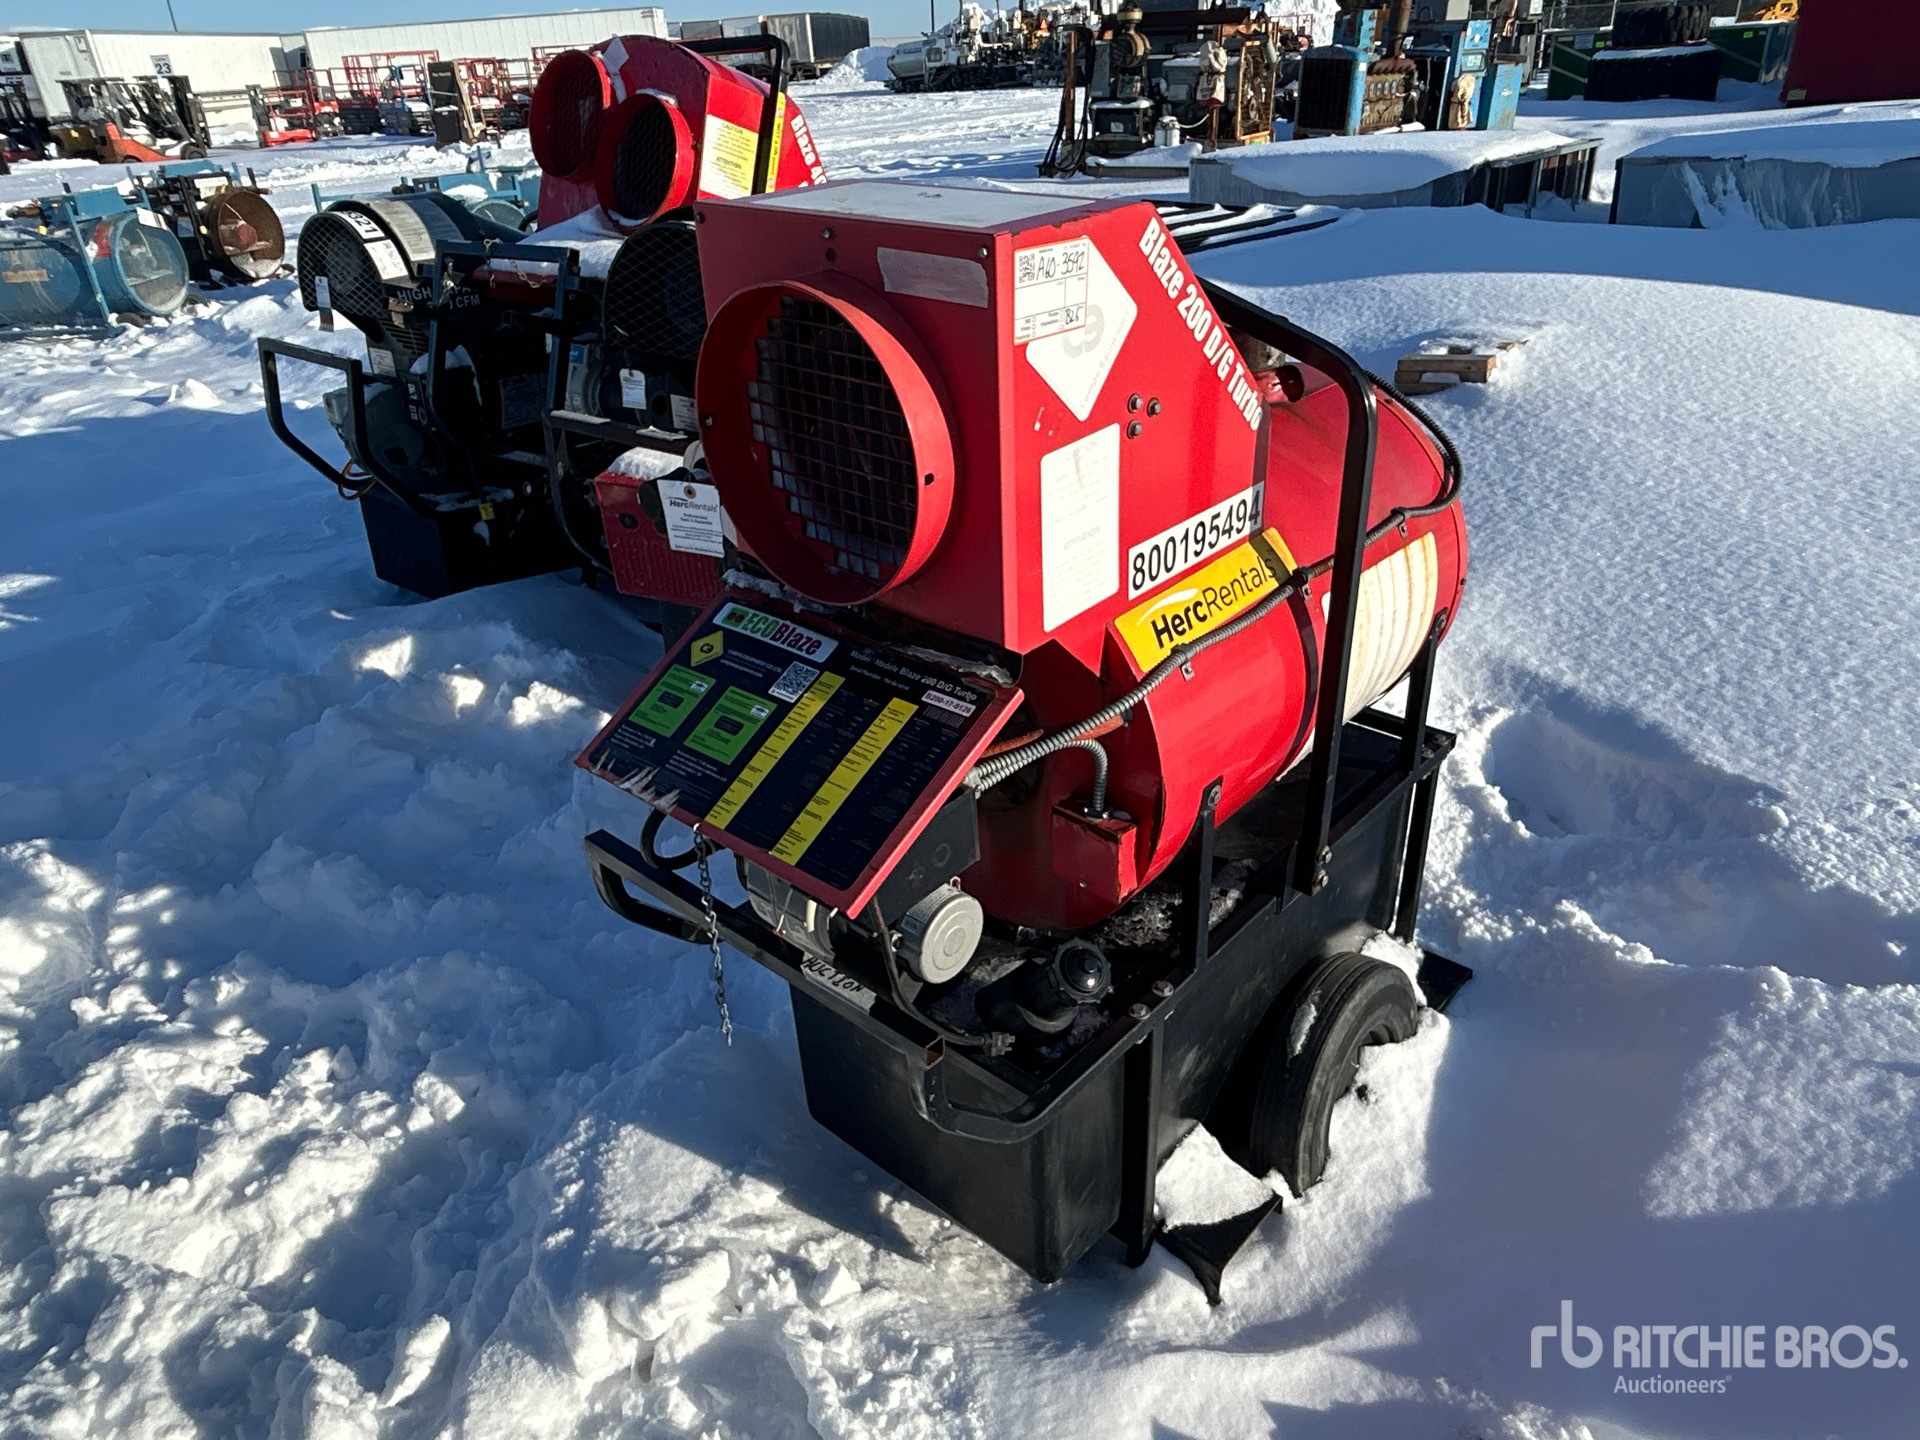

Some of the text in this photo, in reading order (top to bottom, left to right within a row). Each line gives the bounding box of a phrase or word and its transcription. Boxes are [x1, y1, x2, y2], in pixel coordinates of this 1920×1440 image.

[155, 62, 172, 74] 23
[790, 114, 816, 166] Blaze
[397, 286, 432, 301] HIGH
[456, 294, 480, 308] CFM
[1138, 216, 1264, 431] Blaze 200 D/G Turbo
[669, 499, 718, 513] HercRentals
[1131, 489, 1261, 591] 800195494
[1151, 555, 1277, 649] HercRentals
[741, 613, 823, 656] ECOBlaze
[921, 674, 937, 687] 200
[936, 680, 954, 693] D/G
[953, 686, 978, 702] Turbo
[800, 956, 864, 992] AUCTION
